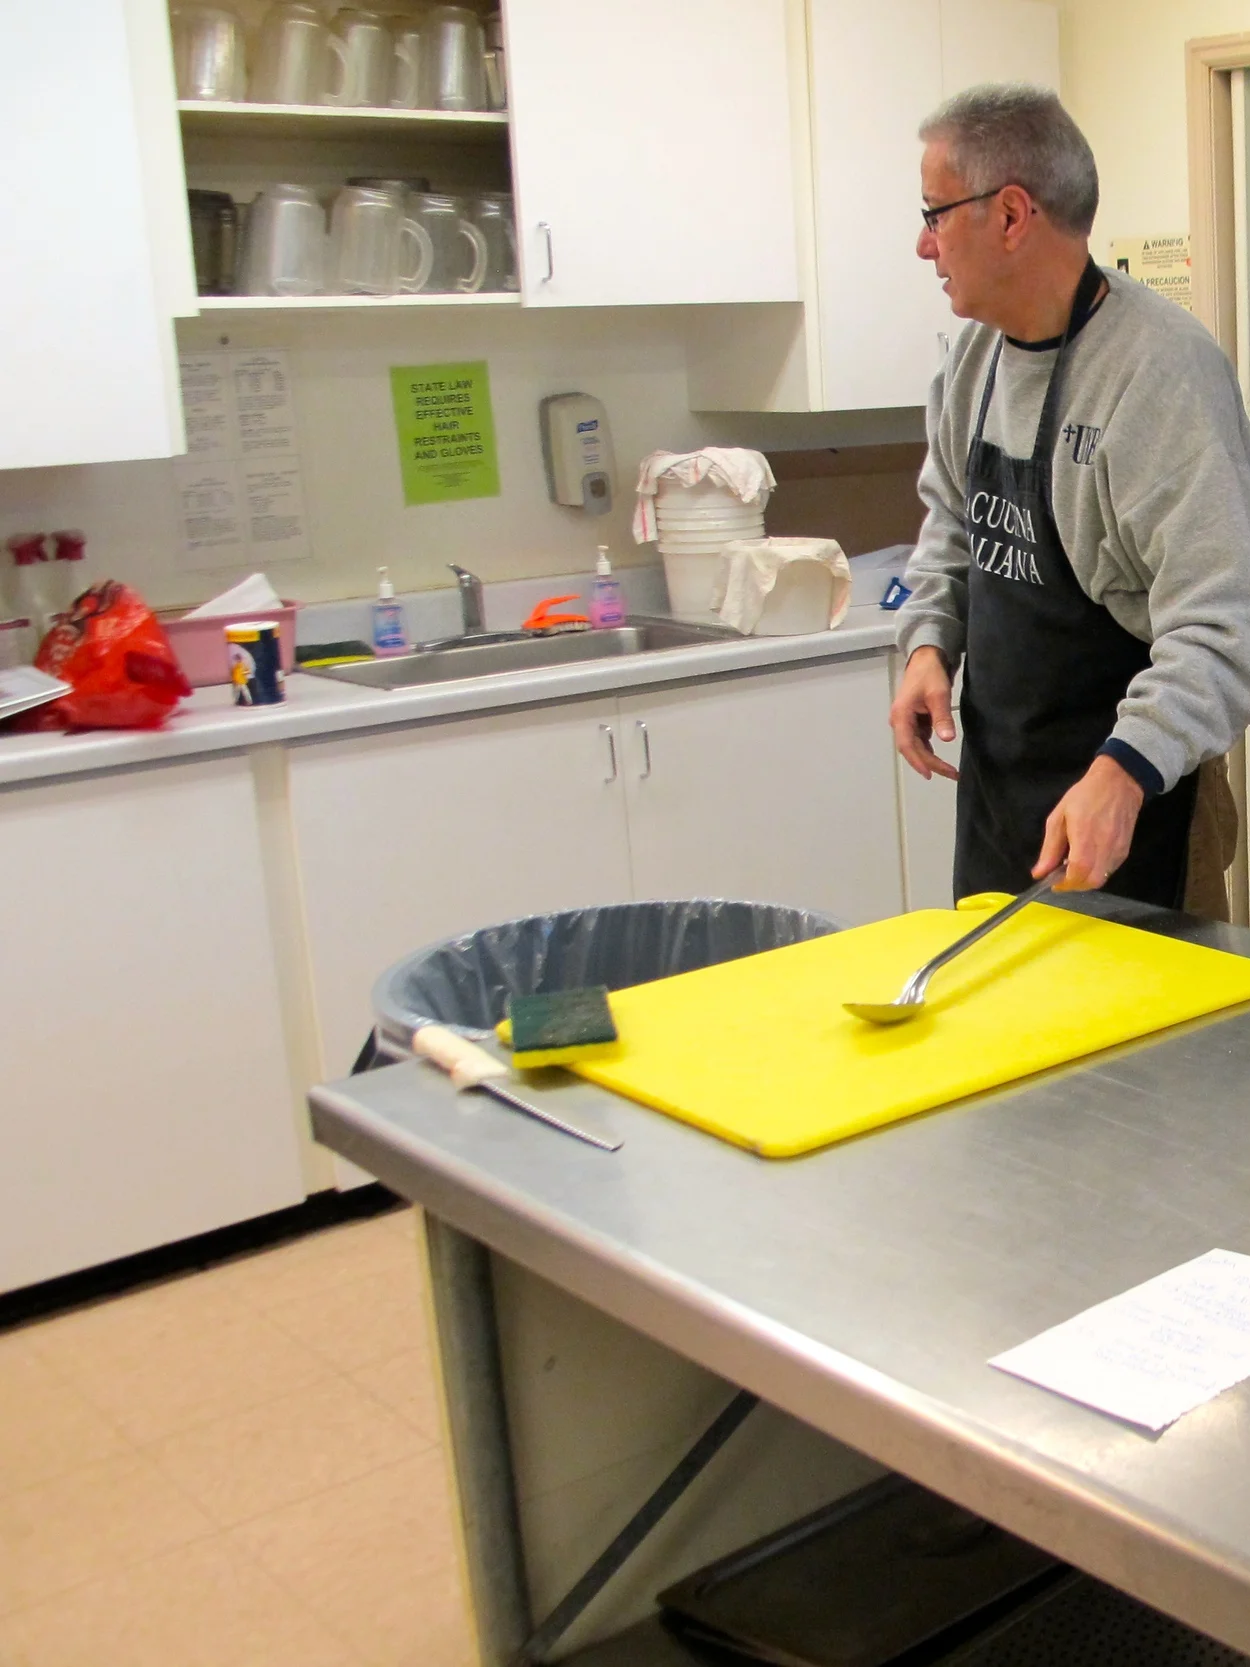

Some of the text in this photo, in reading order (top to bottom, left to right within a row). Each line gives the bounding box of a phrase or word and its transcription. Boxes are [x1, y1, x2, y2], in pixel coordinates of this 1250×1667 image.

[1151, 238, 1184, 249] WARNING
[411, 379, 473, 393] STATE LAW
[416, 393, 471, 406] REQUIRES
[416, 406, 474, 420] EFFECTIVE
[433, 420, 460, 431] HAIR
[414, 432, 481, 446] RESTRAINTS
[414, 444, 484, 460] AND GLOVES
[971, 533, 1044, 585] LIANA
